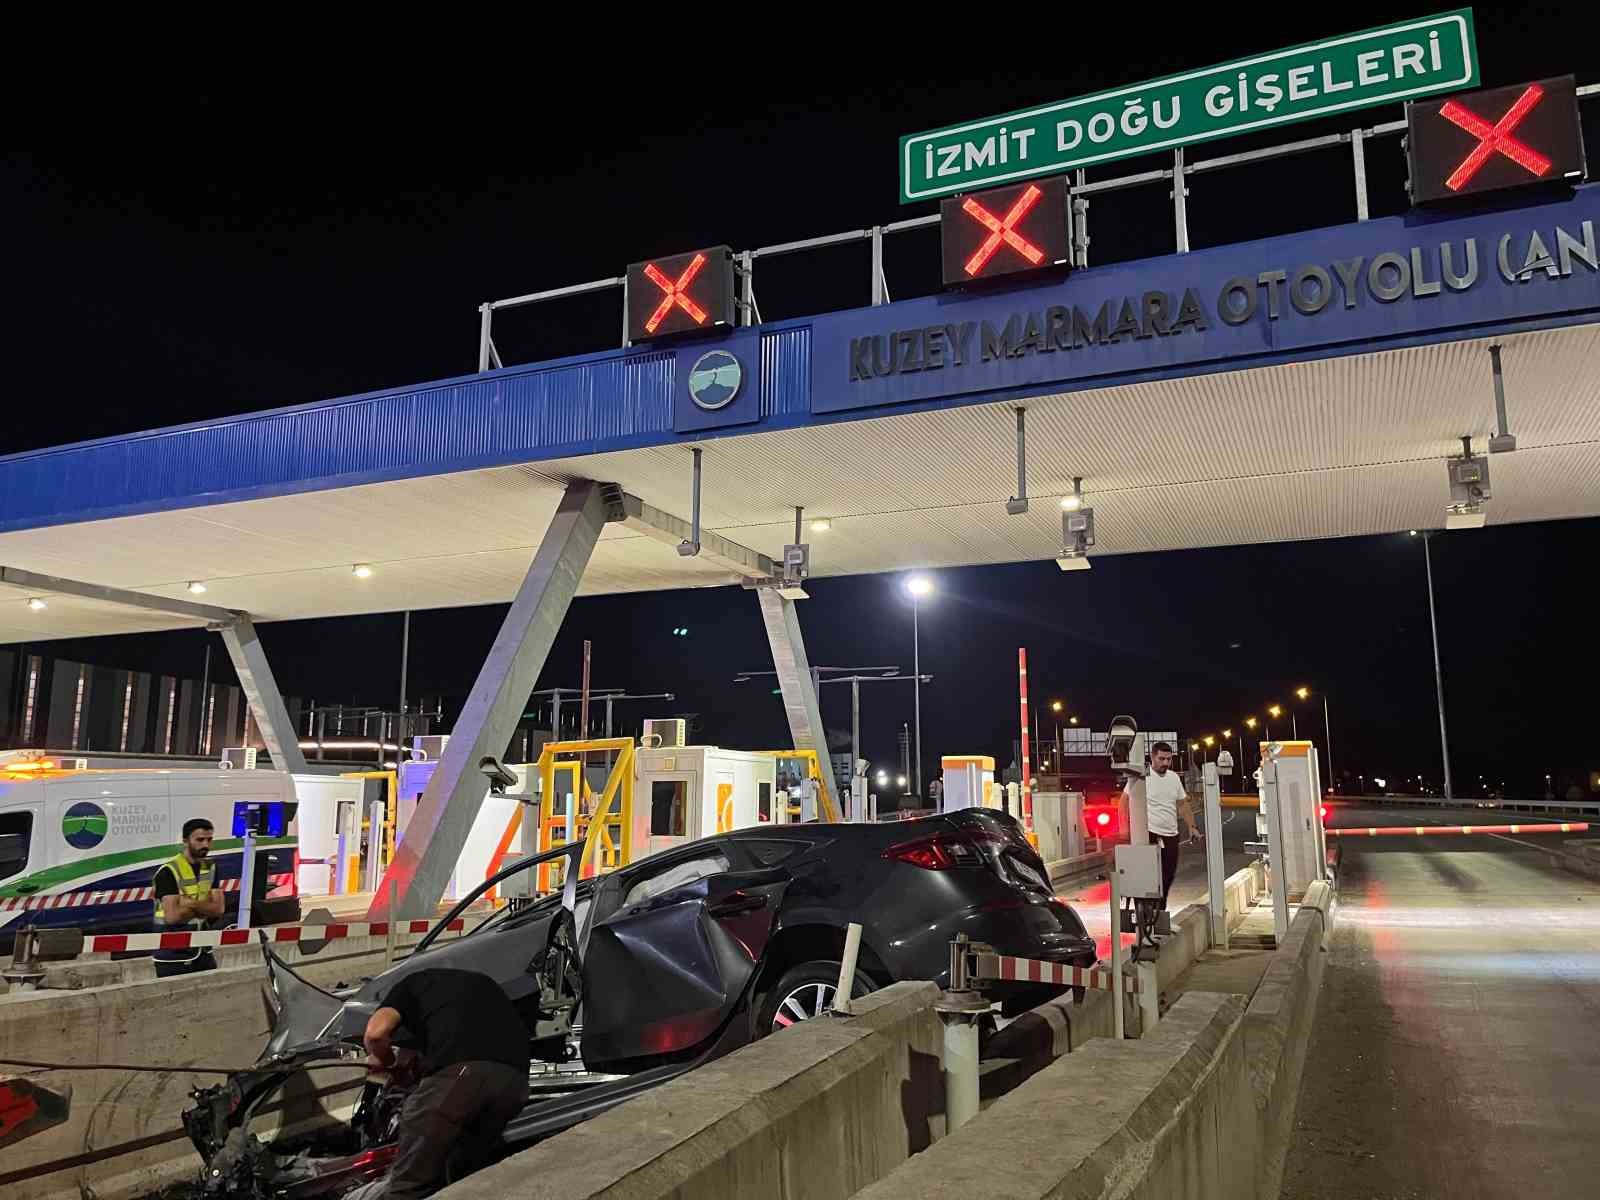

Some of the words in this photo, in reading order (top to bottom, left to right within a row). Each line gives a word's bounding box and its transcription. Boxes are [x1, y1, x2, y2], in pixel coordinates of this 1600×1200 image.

[923, 138, 1036, 179] İZMİT
[1056, 94, 1181, 150] DOĞU
[1204, 30, 1442, 118] GİŞELERİ
[849, 320, 978, 381] KUZEY
[979, 287, 1208, 361] MARMARA
[1217, 238, 1479, 324] OTOYOLU
[1498, 220, 1600, 281] (AN
